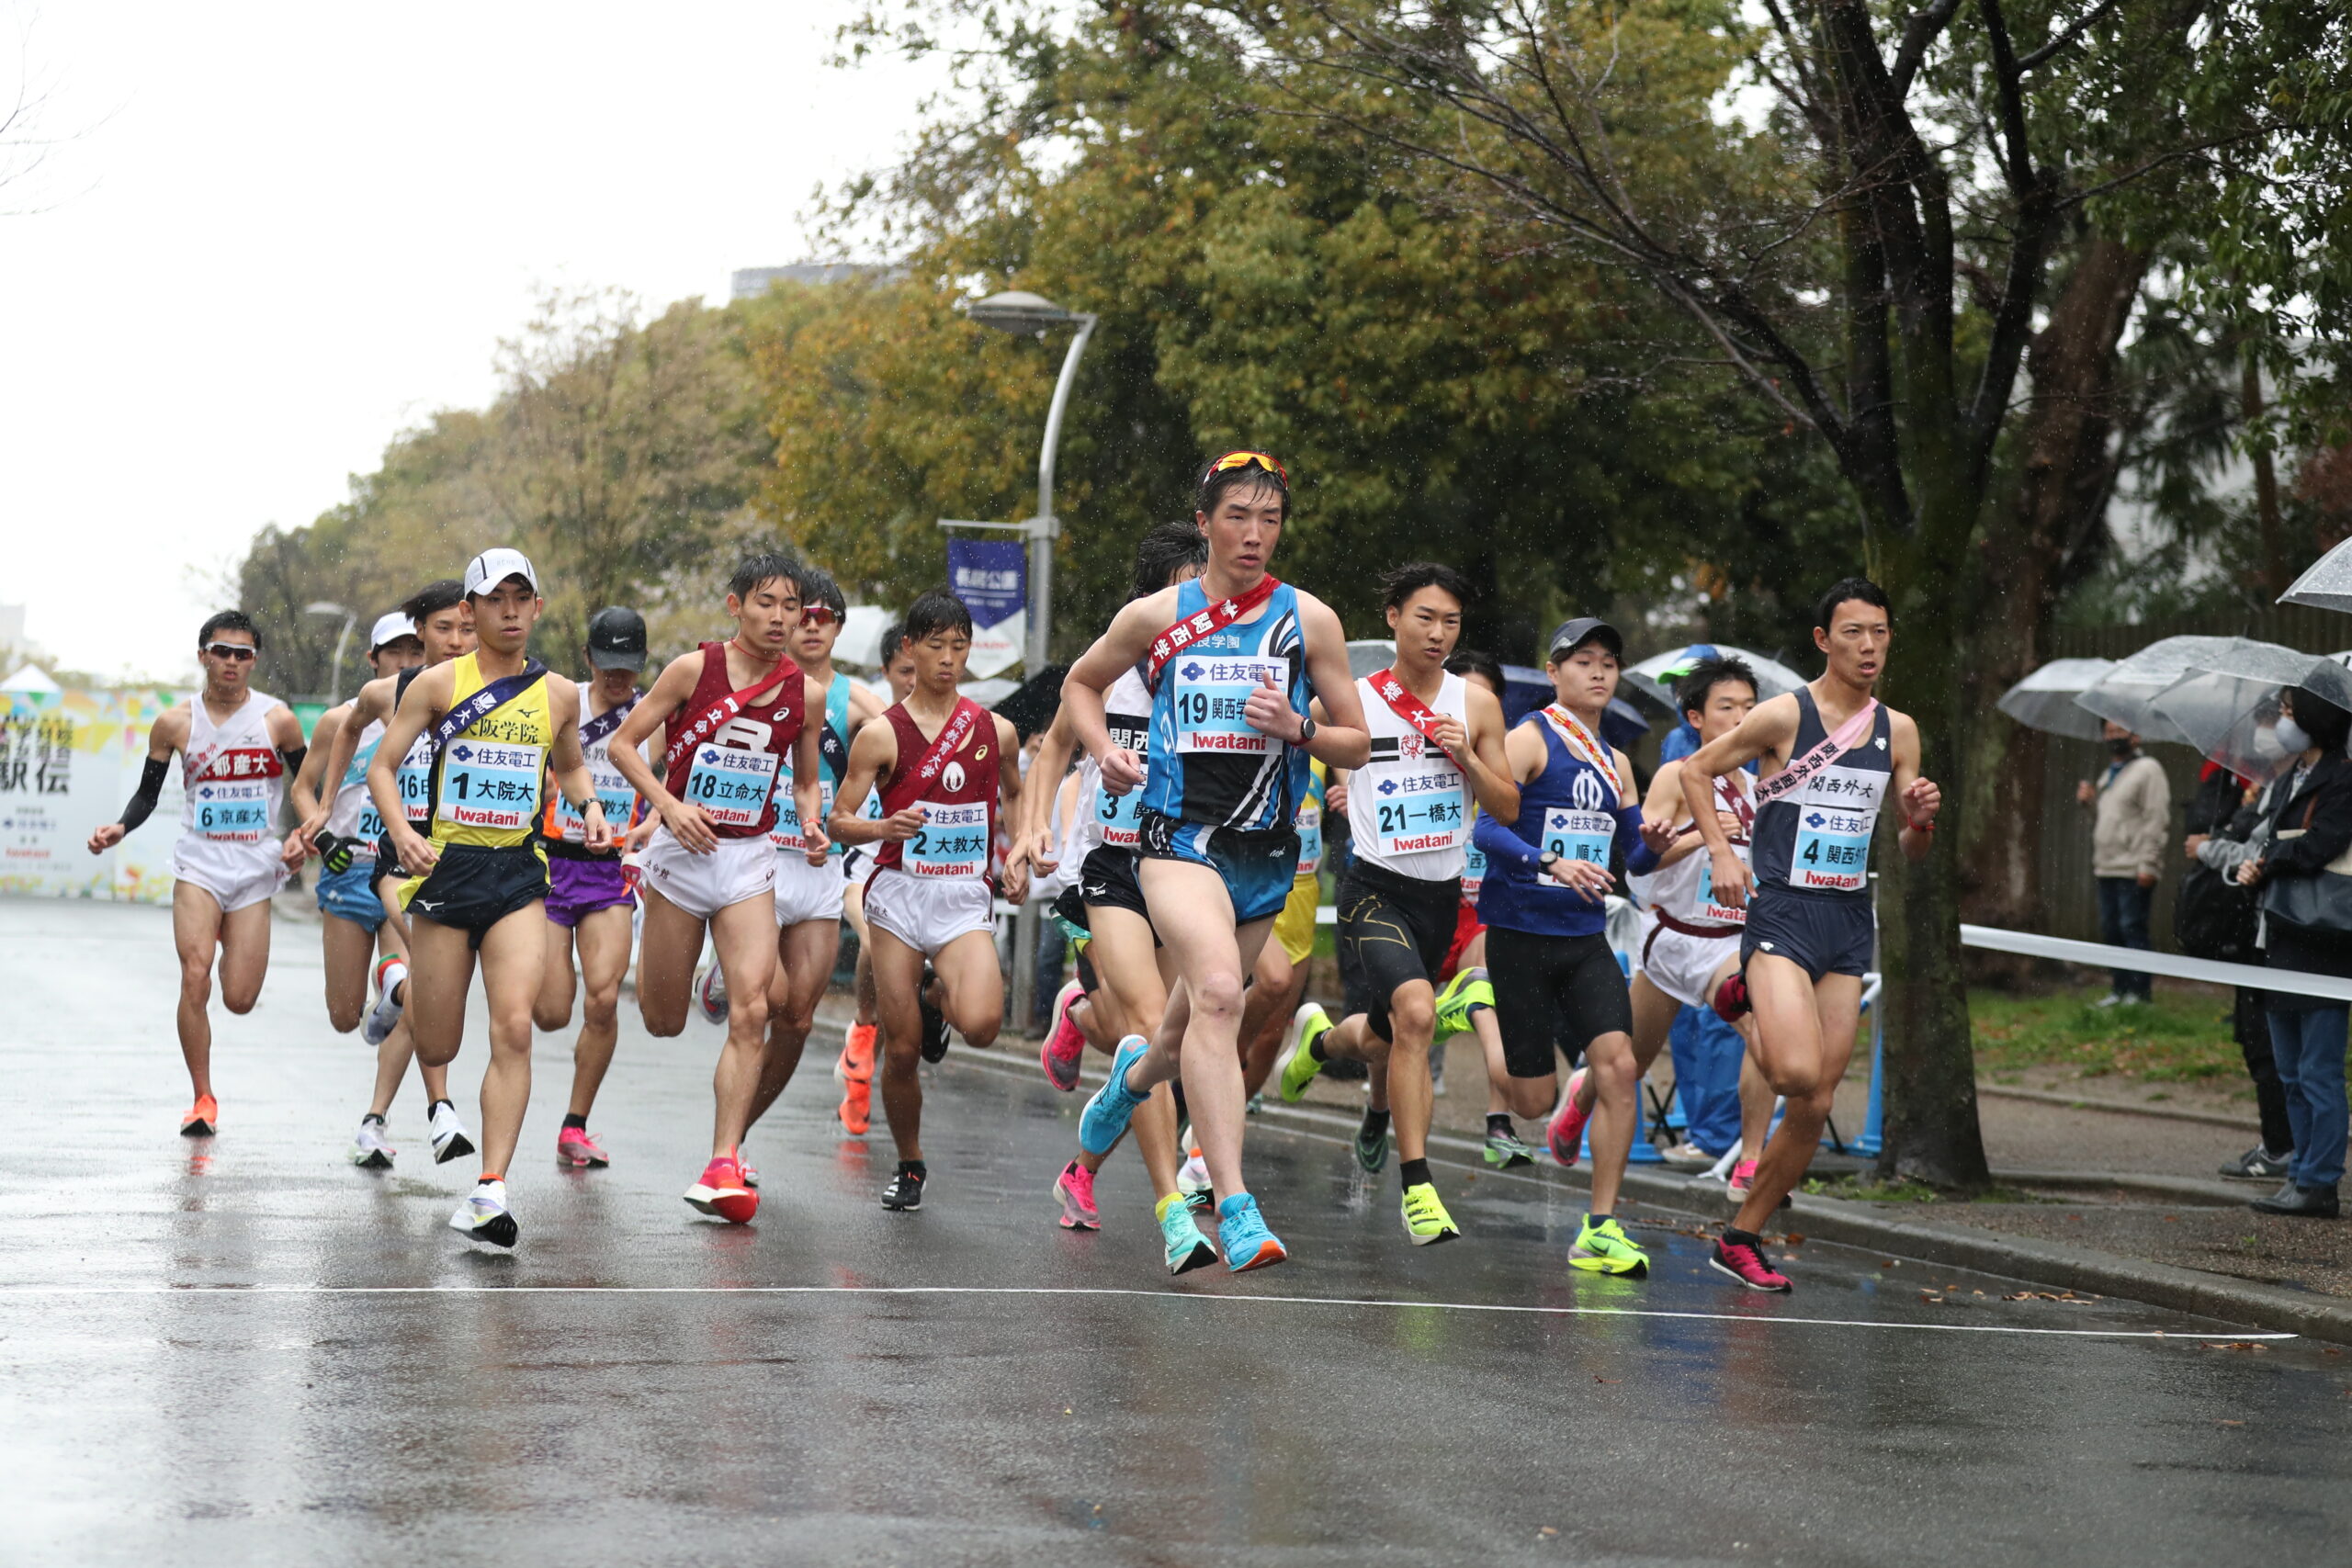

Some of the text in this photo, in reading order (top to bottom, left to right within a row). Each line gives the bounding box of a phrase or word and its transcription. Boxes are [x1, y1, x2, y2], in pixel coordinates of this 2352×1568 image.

[1189, 635, 1240, 649] 良学園
[1210, 663, 1283, 682] 住友電工
[1179, 693, 1247, 724] 19 関西学
[921, 710, 971, 779] 大阪教育大学
[1193, 732, 1267, 750] Iwatani
[200, 753, 269, 776] 都産大
[477, 748, 536, 767] 住友電工
[723, 753, 774, 773] 住友電工
[0, 761, 70, 793] 駅伝
[399, 775, 418, 798] 16
[452, 773, 534, 802] 1 大院大
[692, 773, 766, 802] 18 立命大
[1402, 773, 1459, 793] 住友電工
[1808, 775, 1874, 798] 関西外大
[217, 786, 264, 799] 住友電工
[201, 807, 266, 827] 6 京産大
[454, 806, 519, 826] Iwatani
[934, 809, 984, 824] 住友電工
[1102, 795, 1118, 819] 3
[1379, 802, 1461, 833] 21 一橋大
[1571, 816, 1612, 832] 住友電工
[1829, 815, 1871, 833] 住友工
[912, 830, 985, 855] 2 大教大
[1394, 831, 1453, 852] Iwatani
[1551, 839, 1603, 863] 9 順大
[1804, 839, 1820, 864] 4
[915, 861, 974, 875] Iwatani
